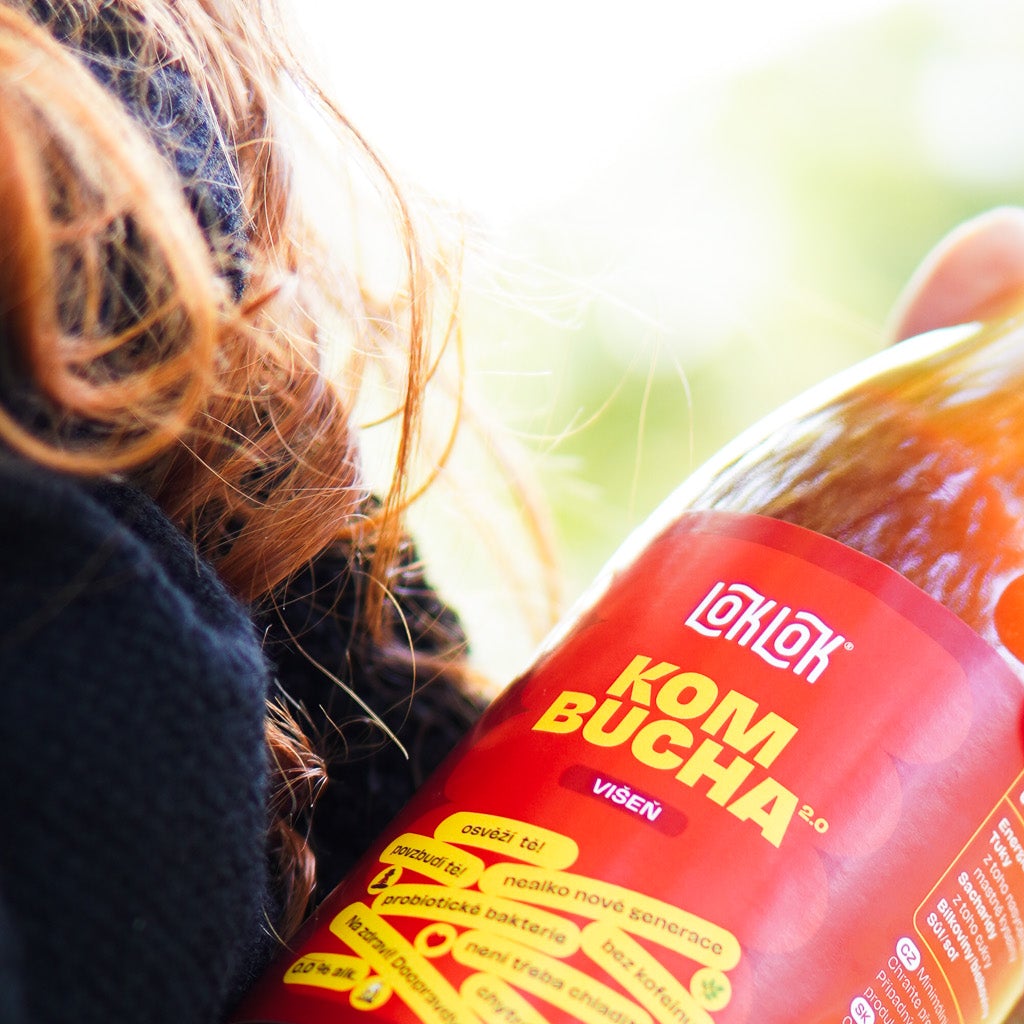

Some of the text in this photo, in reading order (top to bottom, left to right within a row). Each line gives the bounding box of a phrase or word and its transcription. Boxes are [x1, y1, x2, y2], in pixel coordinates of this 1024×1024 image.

[606, 654, 799, 769] KOM
[531, 690, 829, 849] BUCHA 2.0
[592, 777, 663, 822] VIŠEŇ
[989, 830, 1013, 868] Tuky
[983, 853, 993, 866] z
[989, 861, 1009, 896] toho
[345, 914, 362, 931] Na
[381, 894, 567, 946] probiotické bakterie
[503, 874, 723, 956] nealko nové generace
[957, 871, 998, 941] Sacharidy
[464, 939, 510, 965] není
[601, 939, 635, 969] bez
[900, 943, 917, 966] CZ
[952, 893, 993, 970] z toho cukry
[887, 955, 923, 1010] Chraňte
